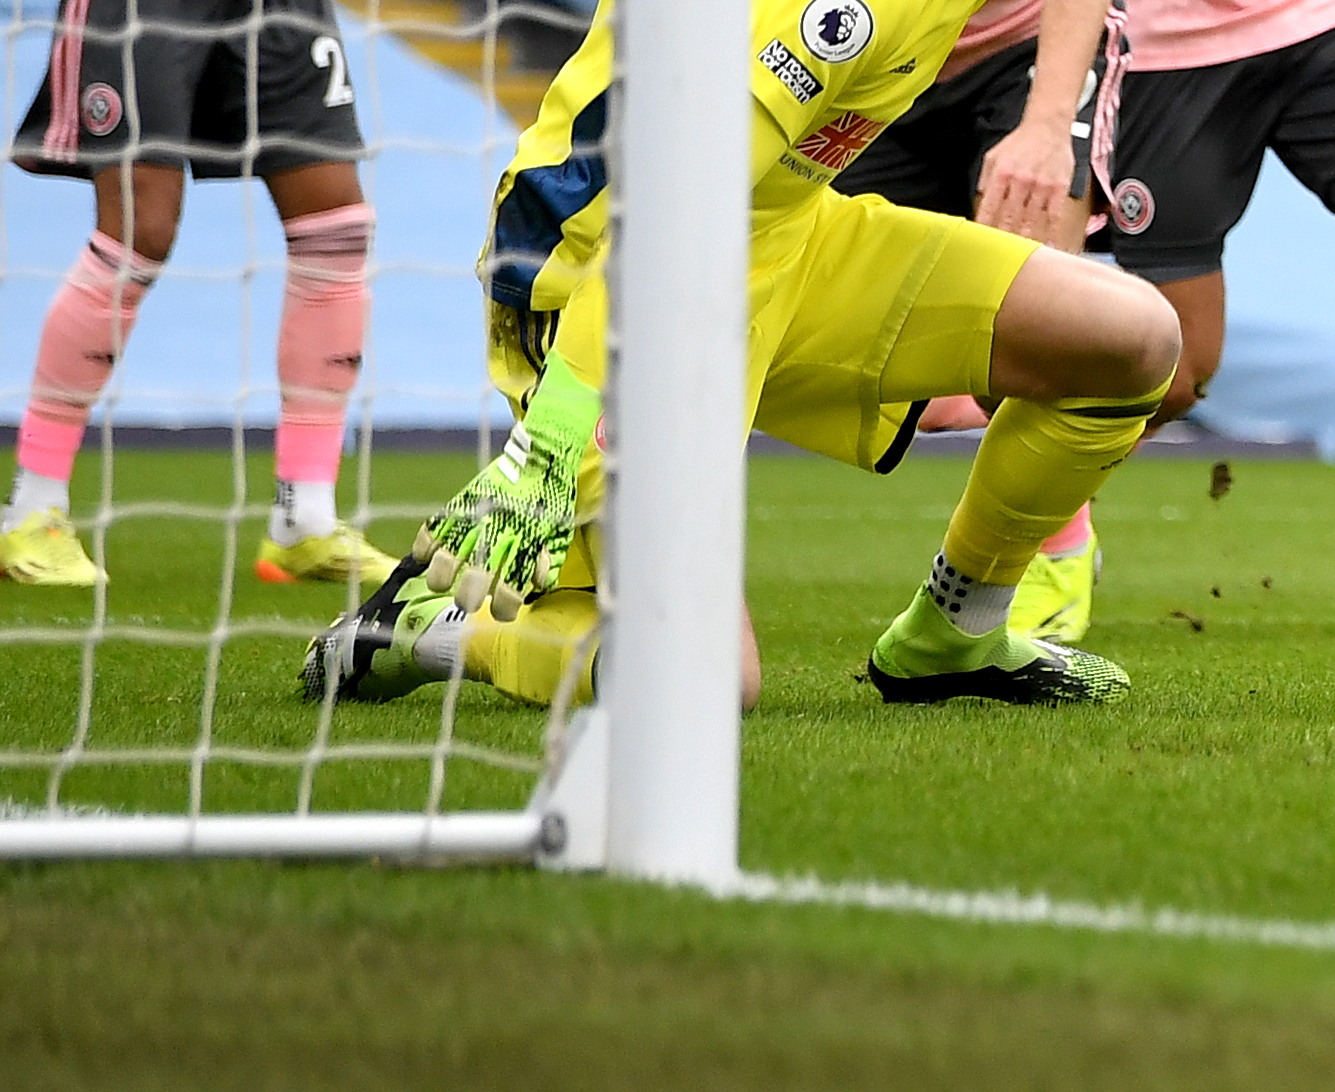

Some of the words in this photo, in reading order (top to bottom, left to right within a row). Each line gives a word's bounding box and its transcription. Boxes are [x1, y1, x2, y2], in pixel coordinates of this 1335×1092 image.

[758, 50, 781, 71] for
[775, 66, 811, 105] racism
[766, 39, 788, 63] No
[785, 58, 816, 92] room
